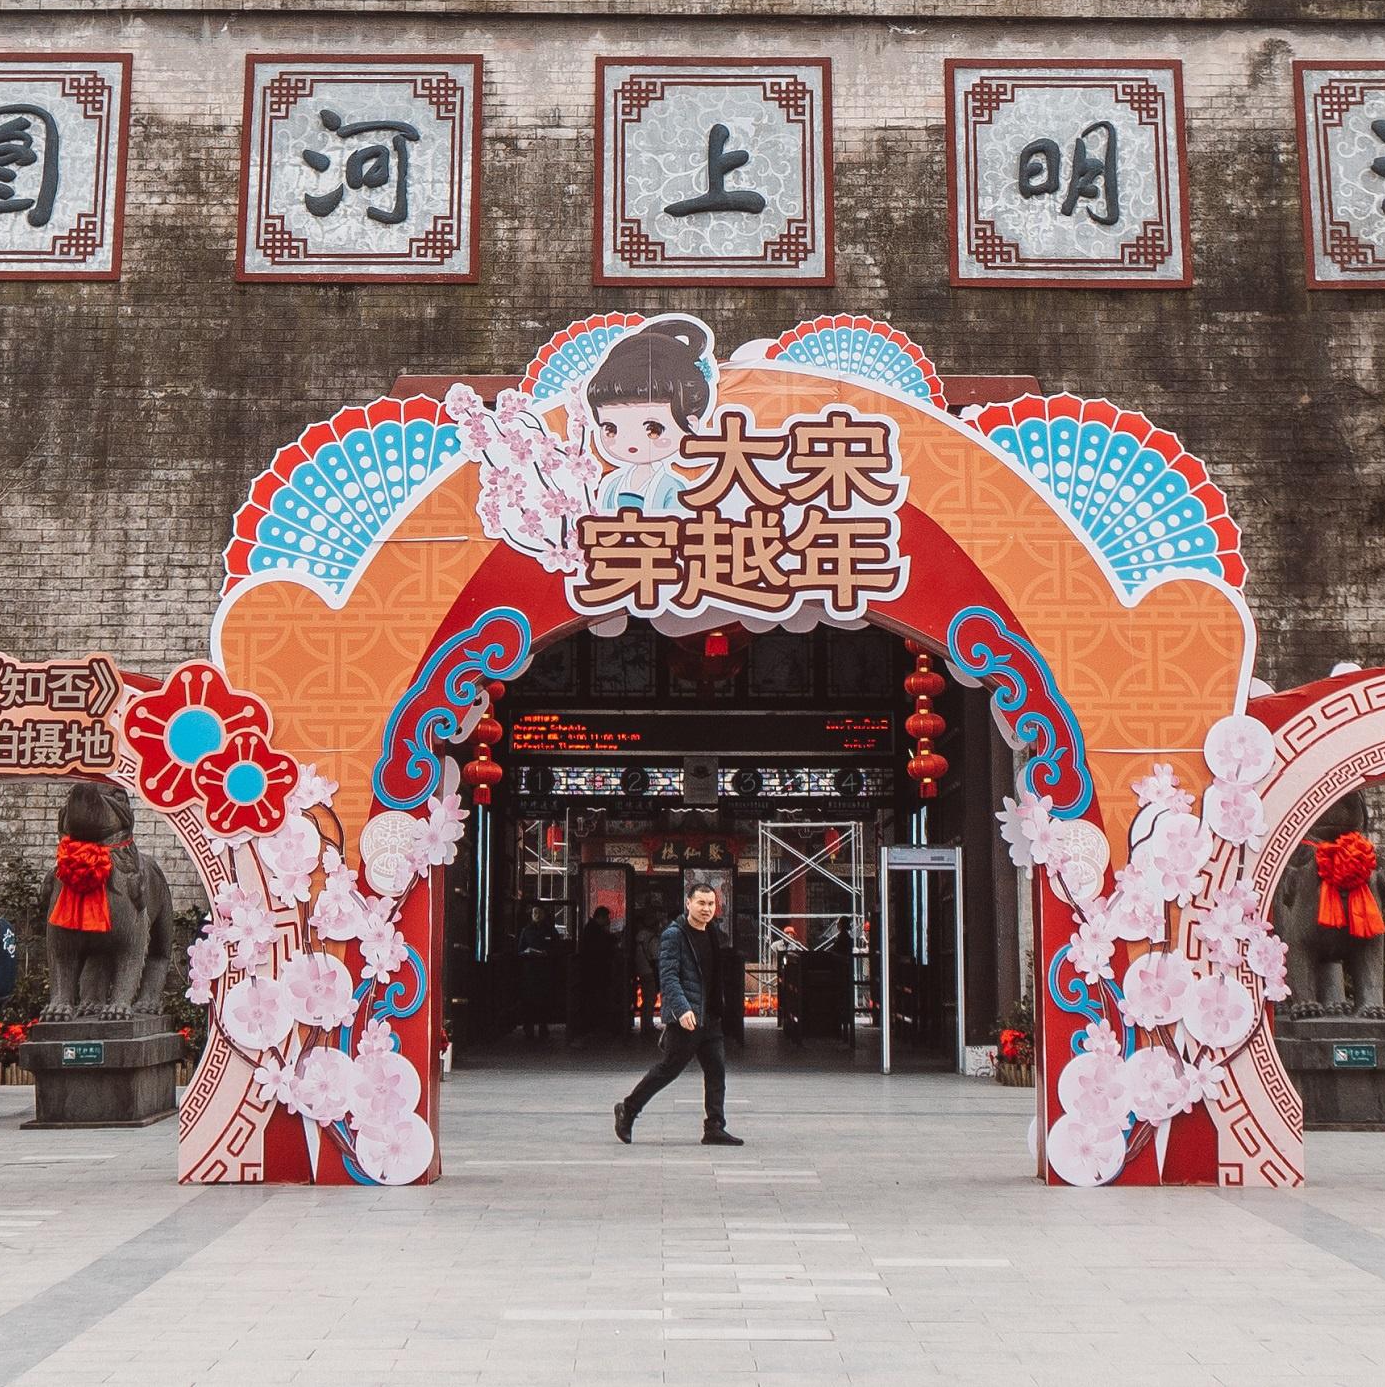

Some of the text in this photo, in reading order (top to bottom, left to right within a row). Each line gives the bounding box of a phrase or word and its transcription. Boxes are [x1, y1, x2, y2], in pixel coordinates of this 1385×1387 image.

[680, 411, 898, 509] 大宋
[575, 507, 899, 609] 穿越年
[627, 771, 643, 792] 2
[740, 773, 756, 793] 3
[841, 773, 858, 793] 4
